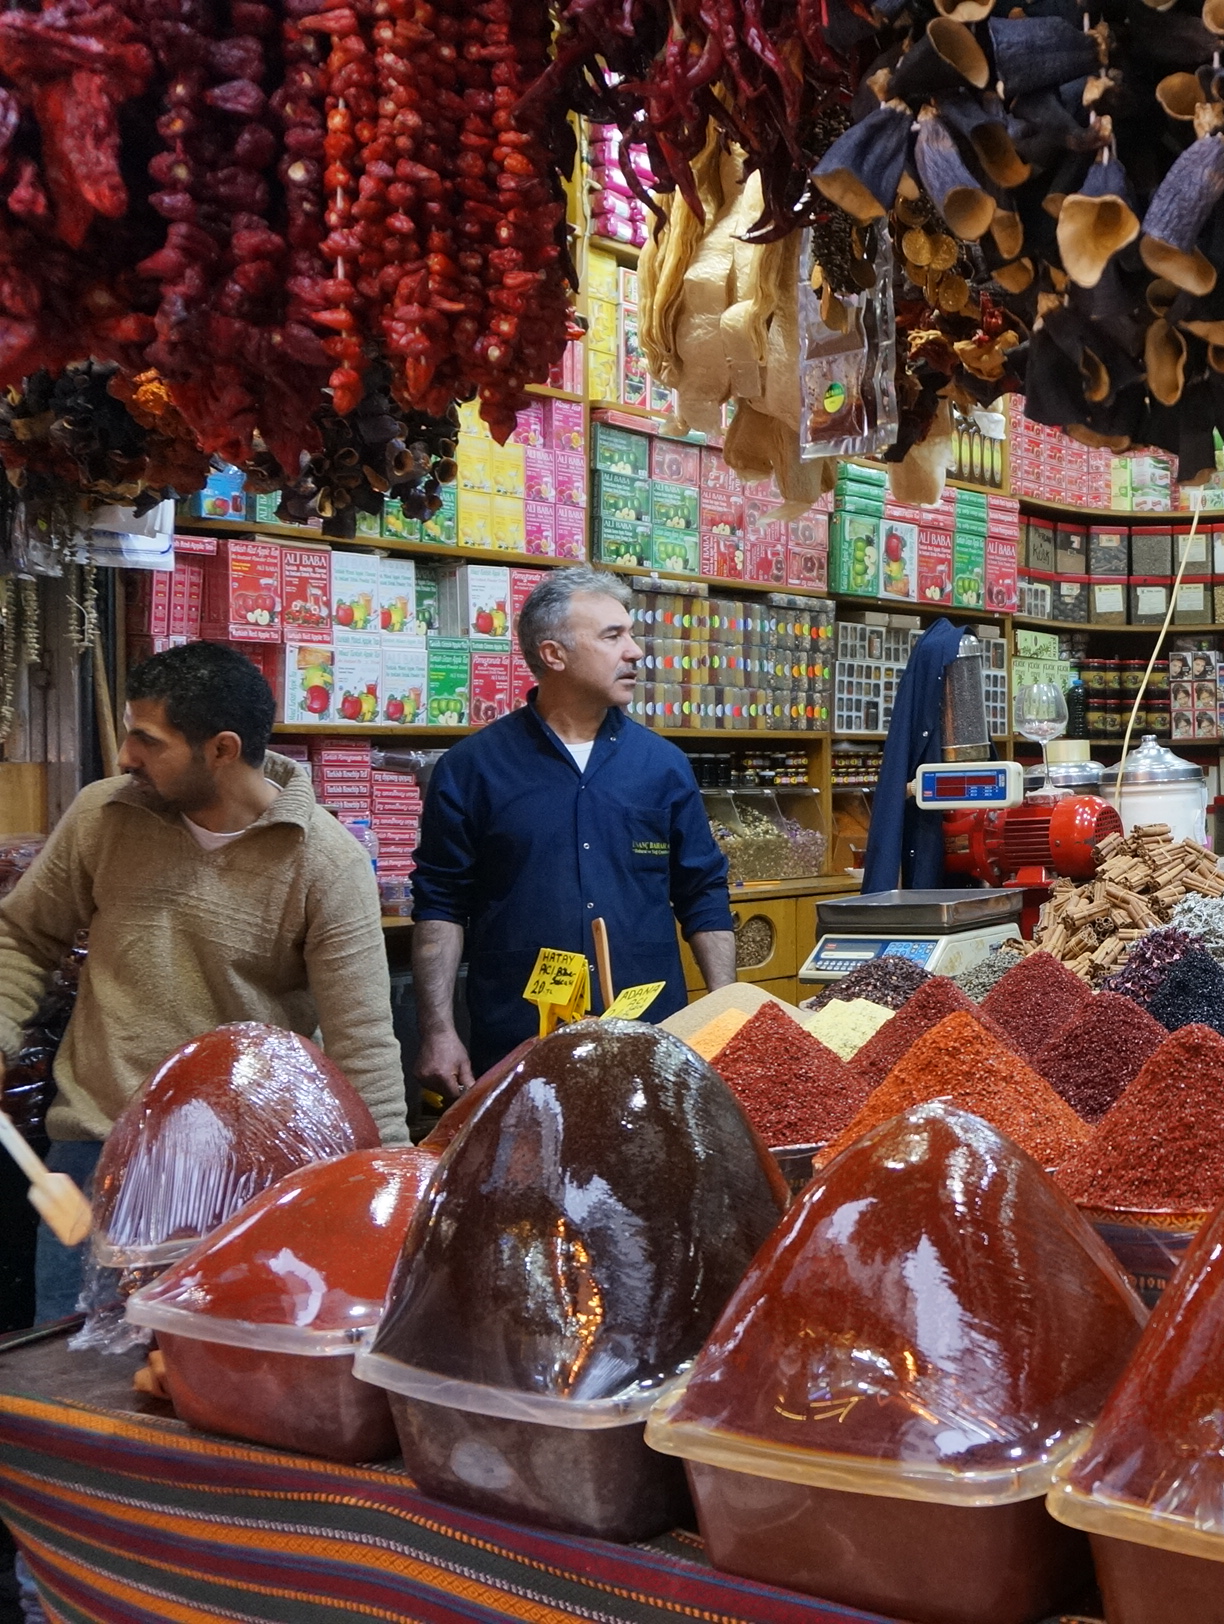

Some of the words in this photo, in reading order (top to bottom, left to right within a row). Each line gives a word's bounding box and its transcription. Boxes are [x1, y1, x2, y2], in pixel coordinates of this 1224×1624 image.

[537, 505, 554, 515] BABA
[569, 509, 584, 519] BABA
[931, 534, 951, 547] BABA
[998, 545, 1016, 557] BABA
[542, 952, 576, 966] HATAY
[620, 984, 660, 1002] ADANA
